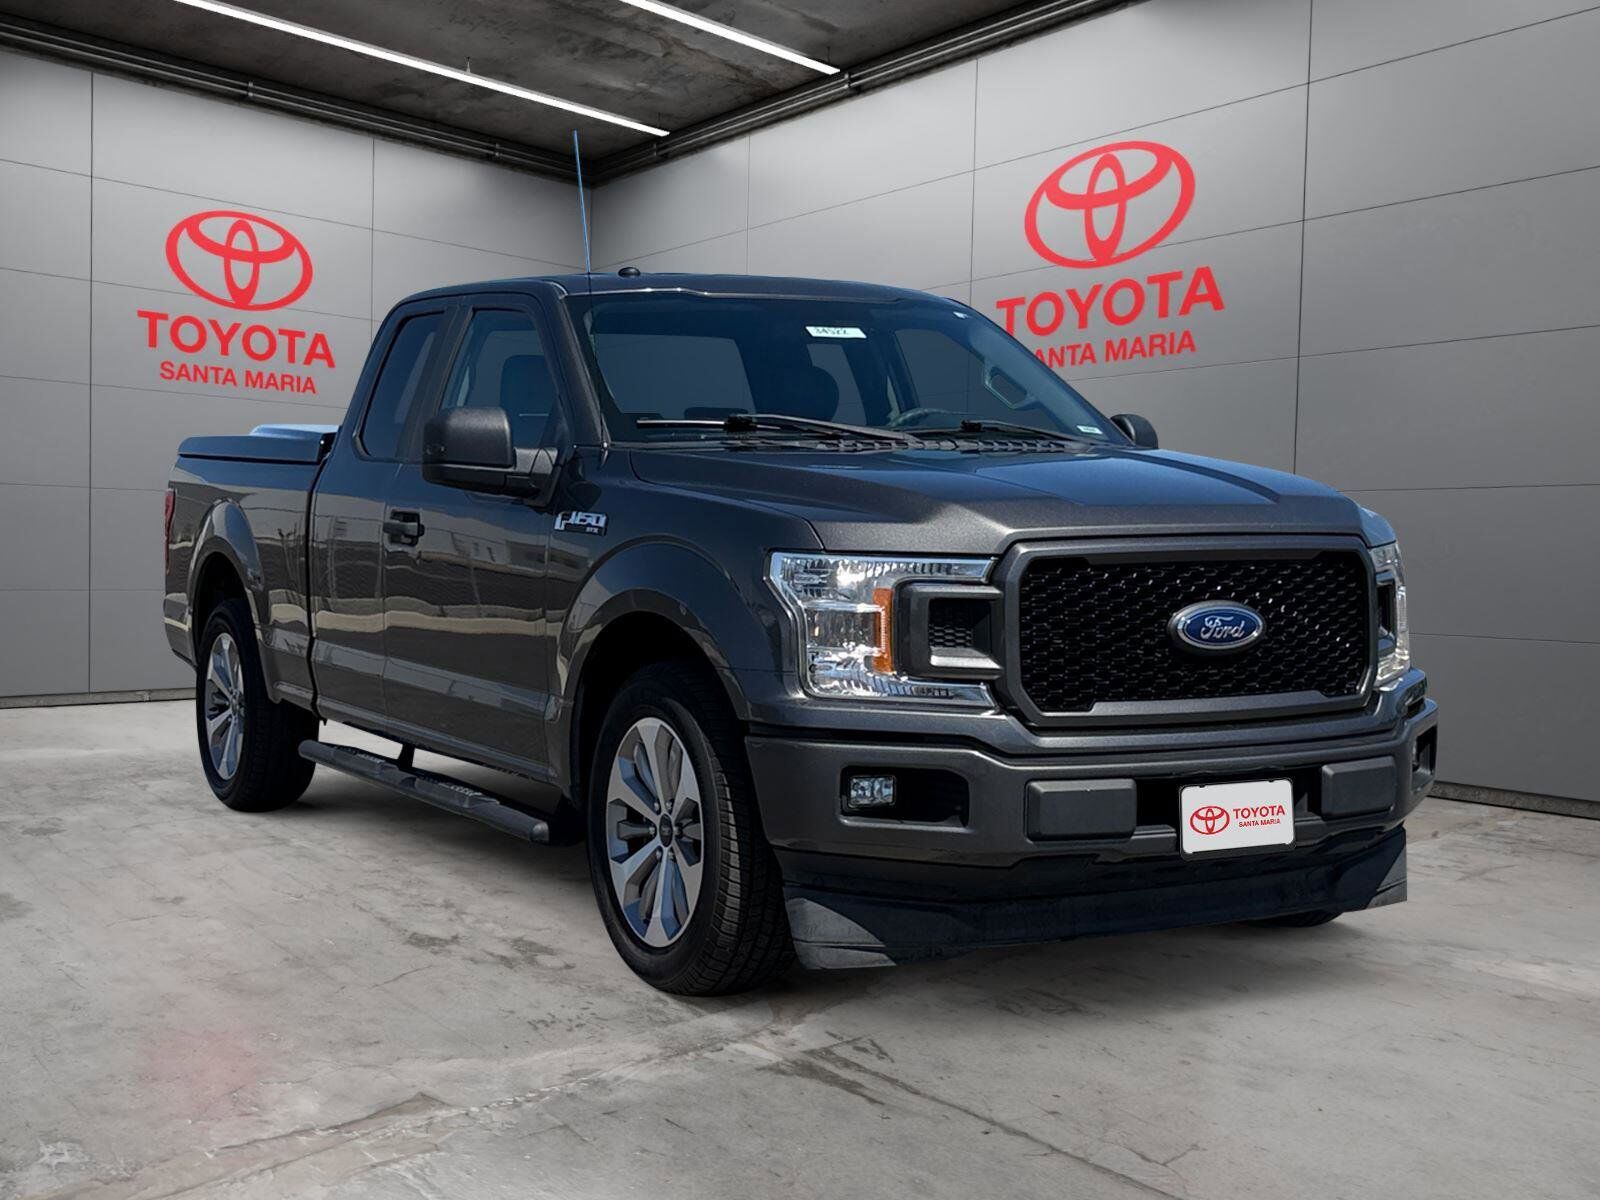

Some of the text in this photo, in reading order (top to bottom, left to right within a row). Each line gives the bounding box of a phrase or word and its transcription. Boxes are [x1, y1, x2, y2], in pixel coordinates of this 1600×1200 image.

[996, 265, 1225, 336] TOYOTA
[137, 310, 335, 368] TOYOTA
[1105, 330, 1196, 362] MARIA
[160, 360, 317, 395] SANTA MARIA
[1200, 615, 1245, 639] Ford
[1233, 805, 1285, 819] TOYOTA
